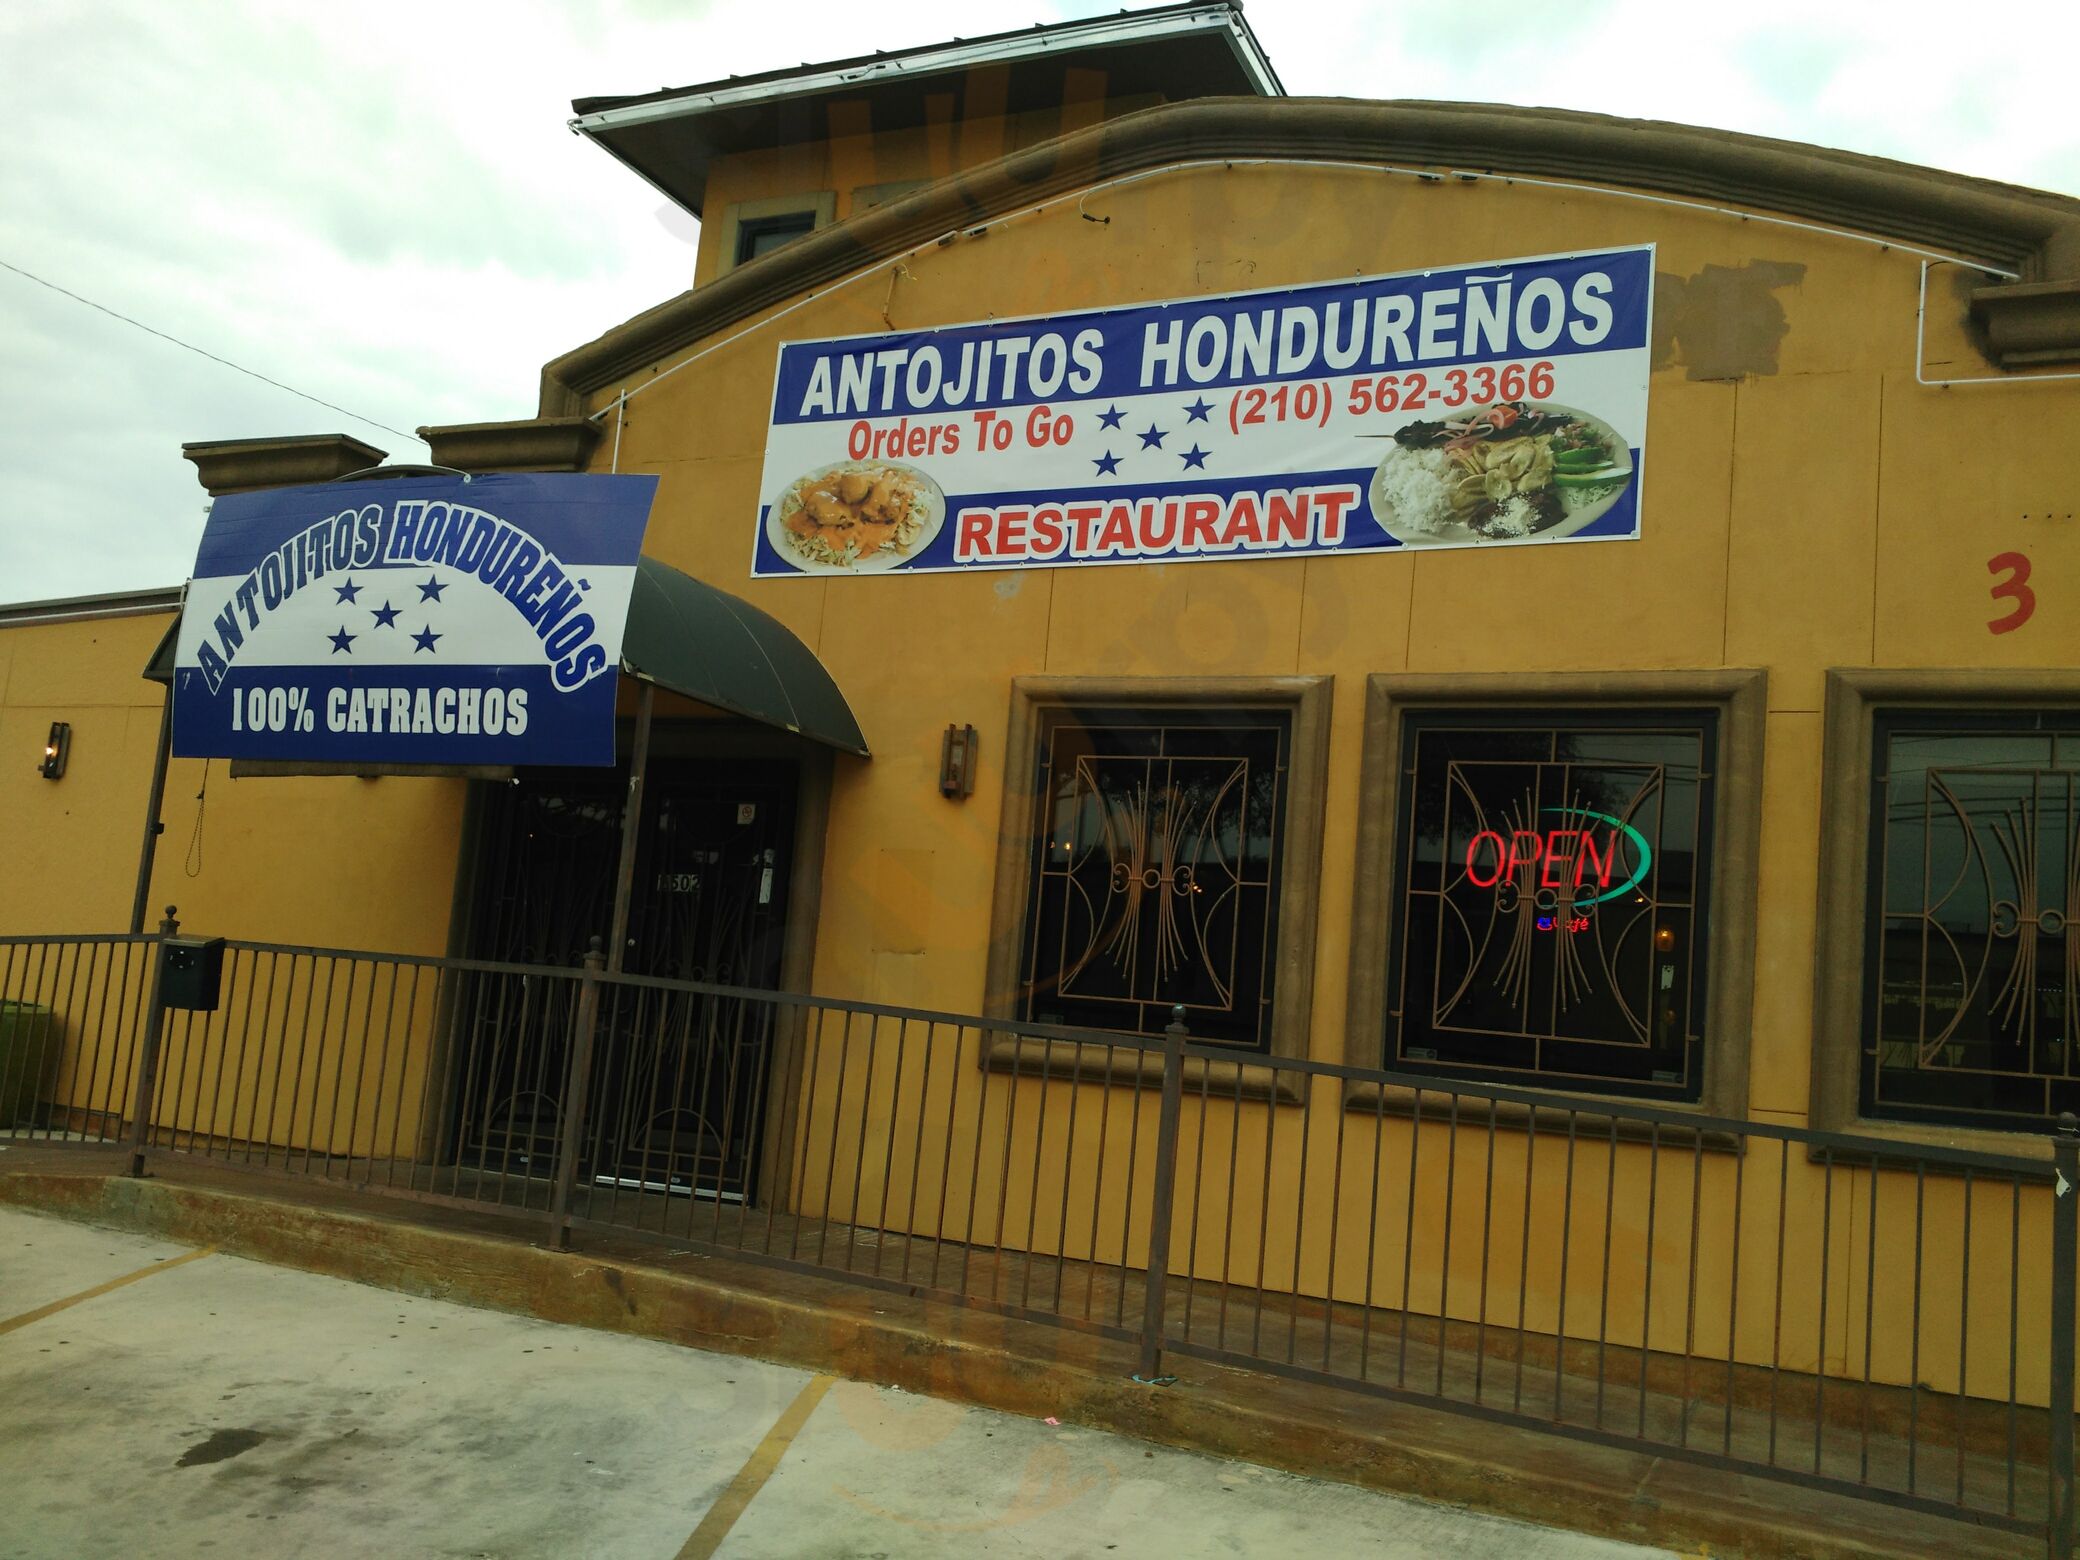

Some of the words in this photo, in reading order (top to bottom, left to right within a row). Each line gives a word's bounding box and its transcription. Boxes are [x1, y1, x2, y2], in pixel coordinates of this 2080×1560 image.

[799, 328, 1104, 417] ANTOJITOS
[1139, 271, 1613, 388] HONDUREÑOS
[1229, 384, 1333, 434] (210)
[1347, 361, 1555, 416] 562-3366
[848, 418, 960, 461] Orders
[974, 410, 1013, 452] To
[1026, 405, 1074, 448] Go
[957, 490, 1356, 557] RESTAURANT
[196, 504, 382, 695] ANTOJITOS
[384, 501, 609, 692] HONDUREÑOS
[1987, 551, 2036, 636] 3
[232, 686, 315, 733] 100%
[327, 687, 529, 737] CATRACHOS
[658, 873, 698, 891] 502
[1466, 830, 1617, 888] OPEN
